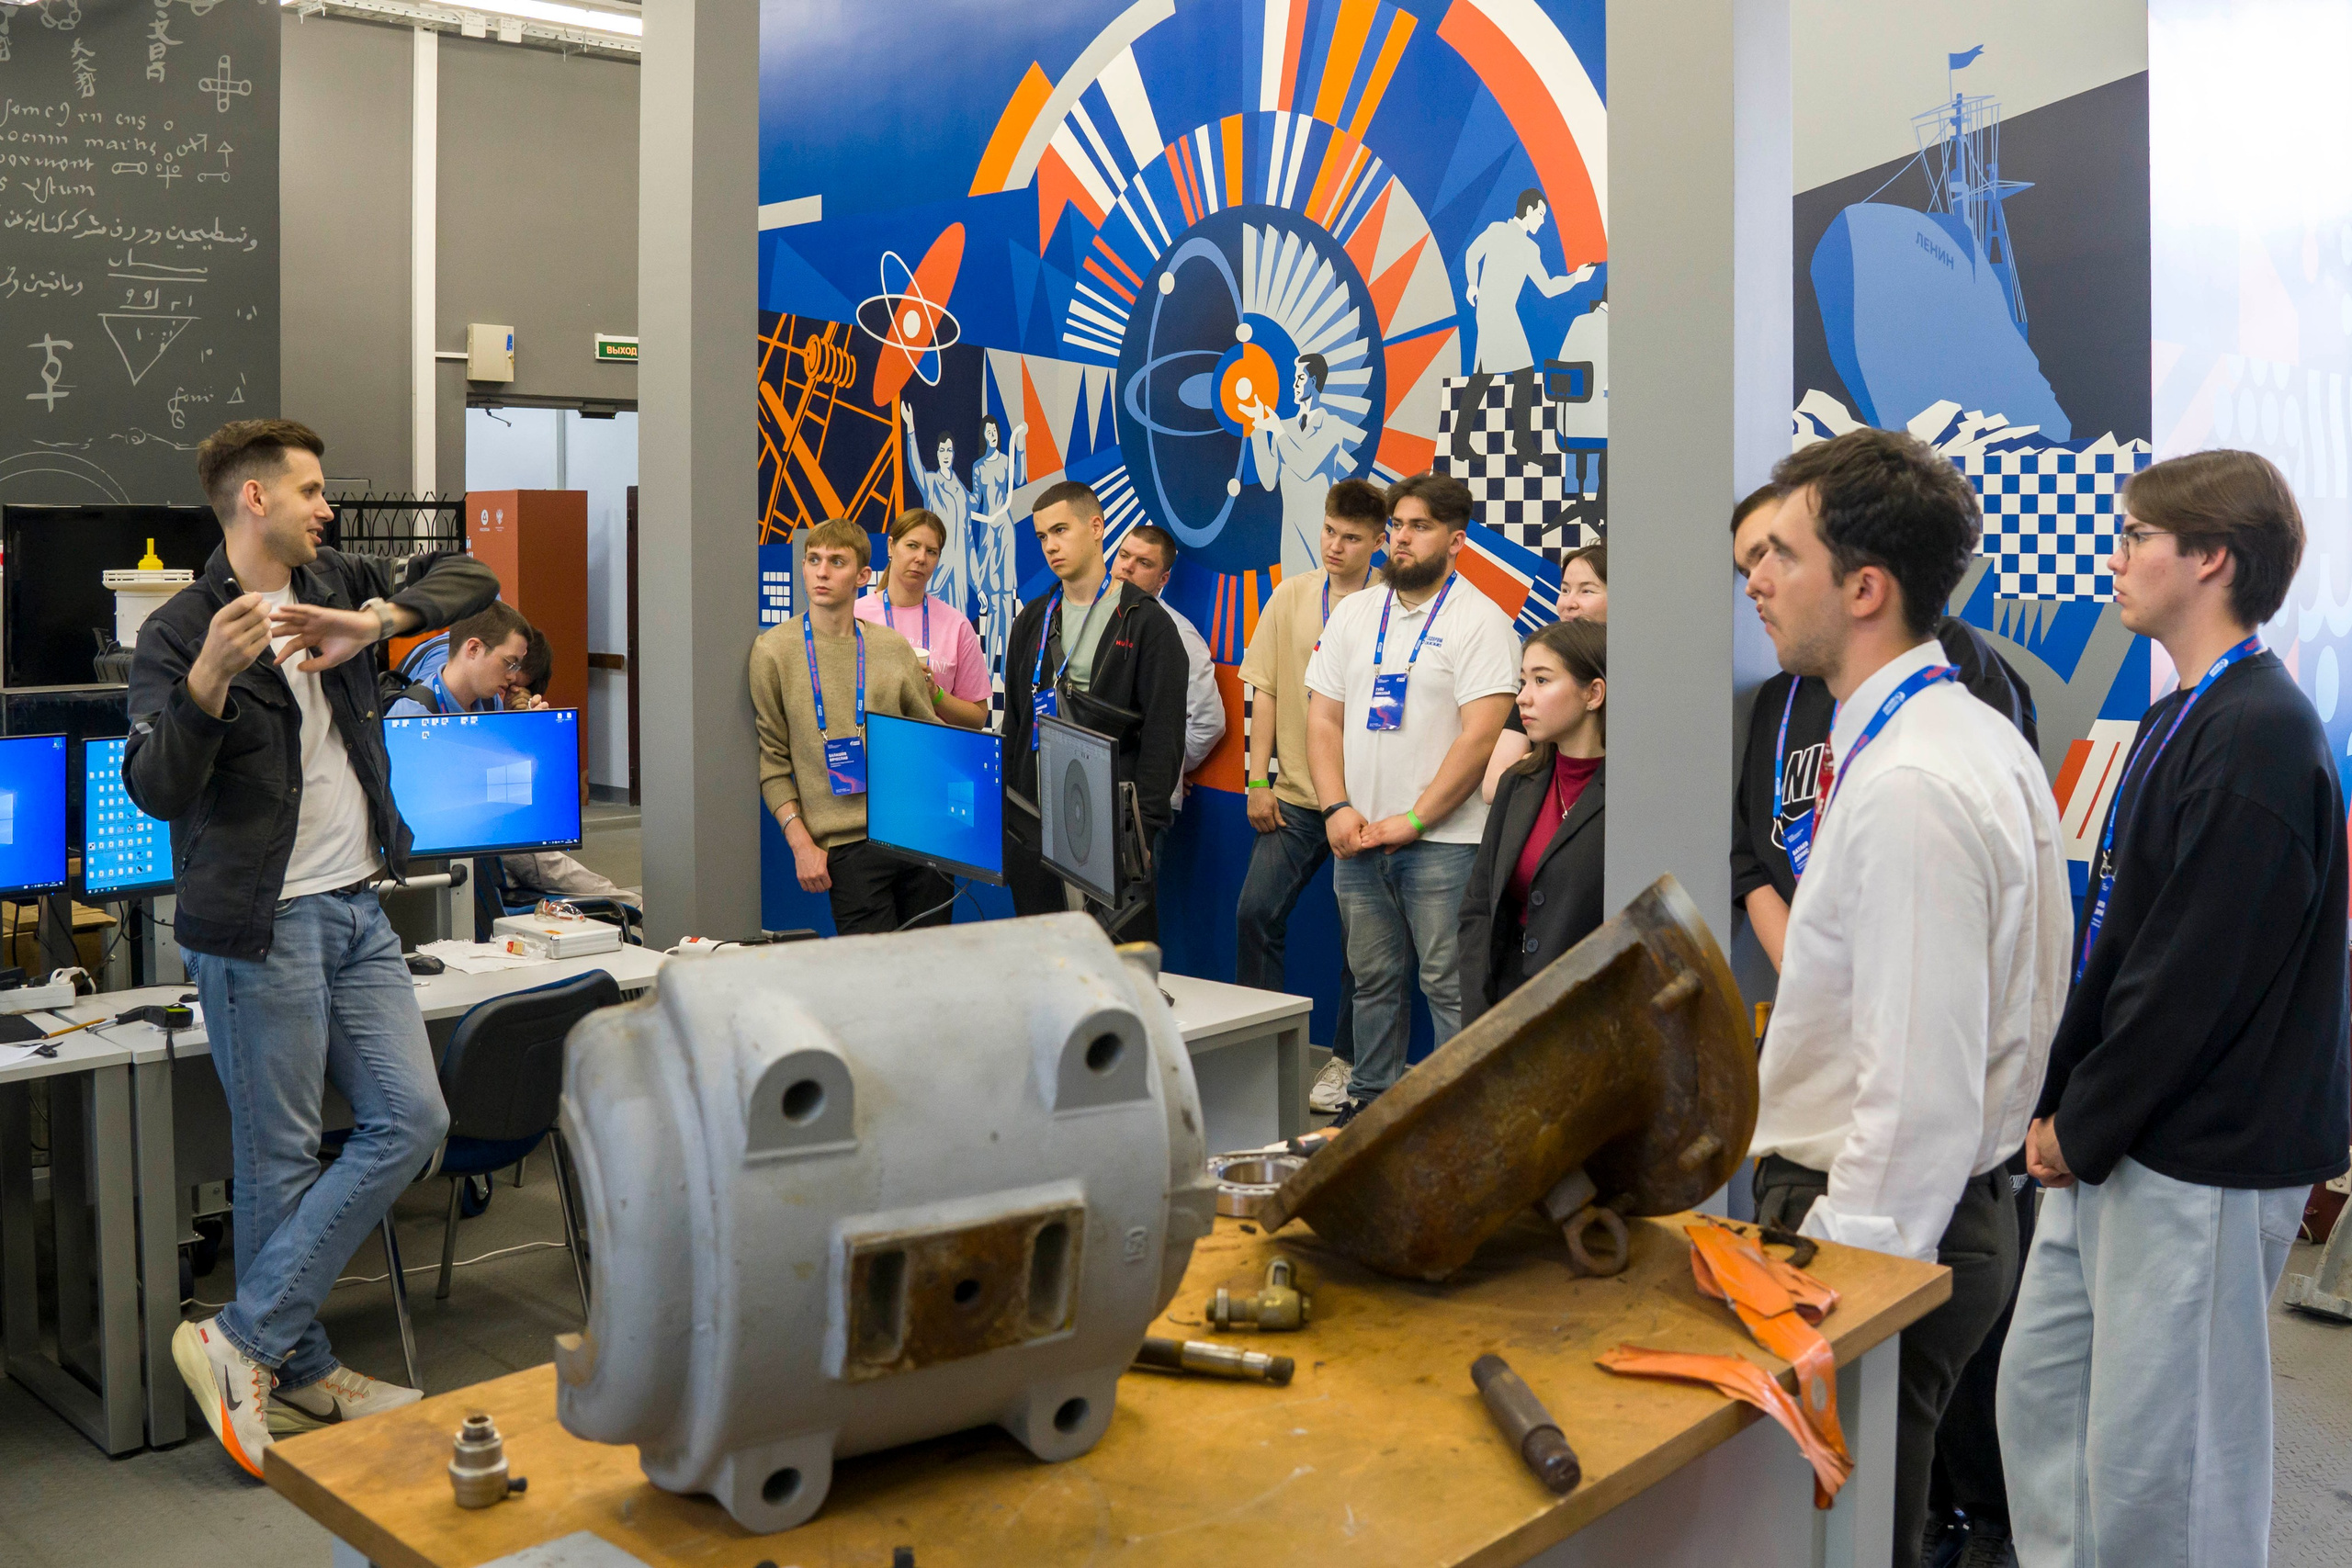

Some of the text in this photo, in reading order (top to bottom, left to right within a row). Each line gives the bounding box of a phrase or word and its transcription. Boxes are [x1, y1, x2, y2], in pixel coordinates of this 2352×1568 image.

[1916, 231, 1954, 270] ЛЕНИН
[606, 345, 638, 357] ВЫХОД
[1781, 743, 1826, 806] NI
